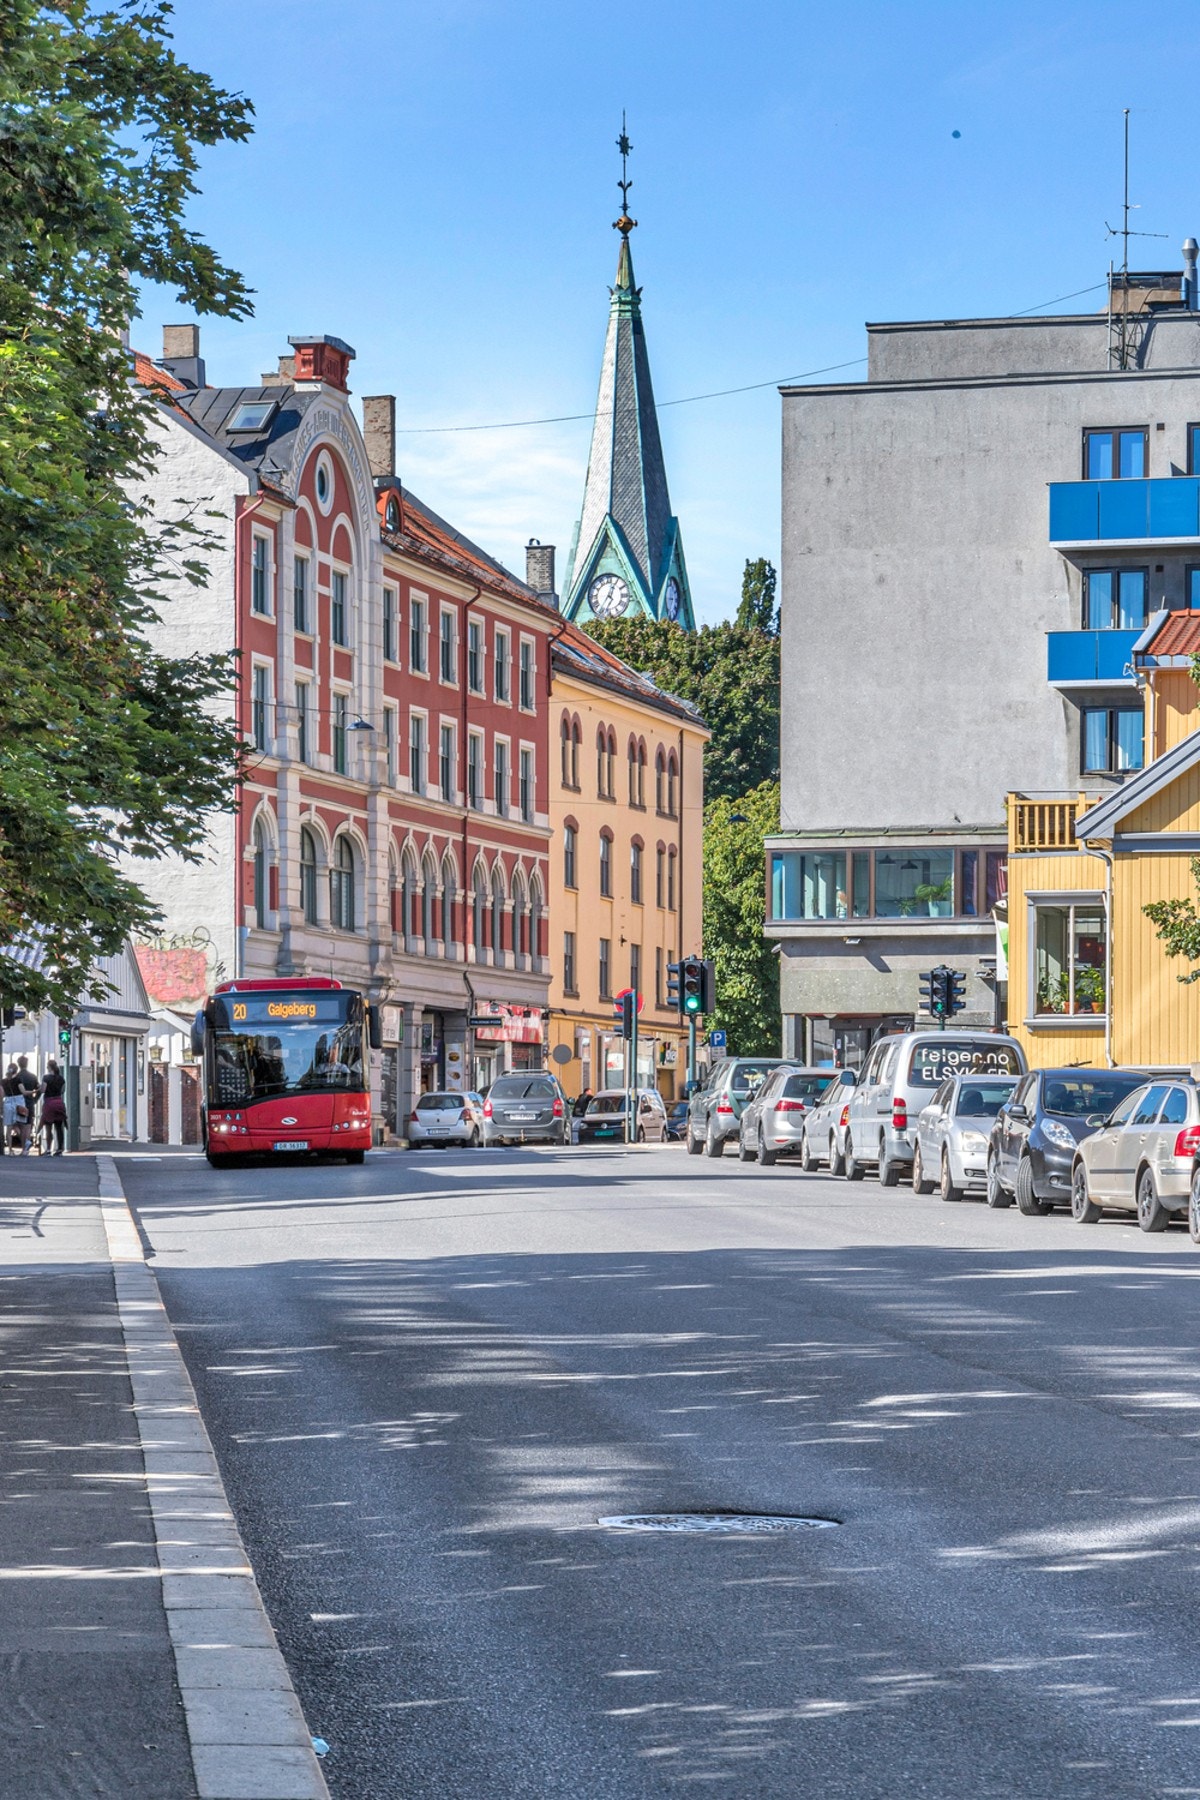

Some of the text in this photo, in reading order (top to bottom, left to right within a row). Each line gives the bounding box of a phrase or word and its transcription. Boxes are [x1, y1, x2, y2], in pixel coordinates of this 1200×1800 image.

[233, 1001, 316, 1020] 20 Galgeberg
[713, 1033, 722, 1045] P
